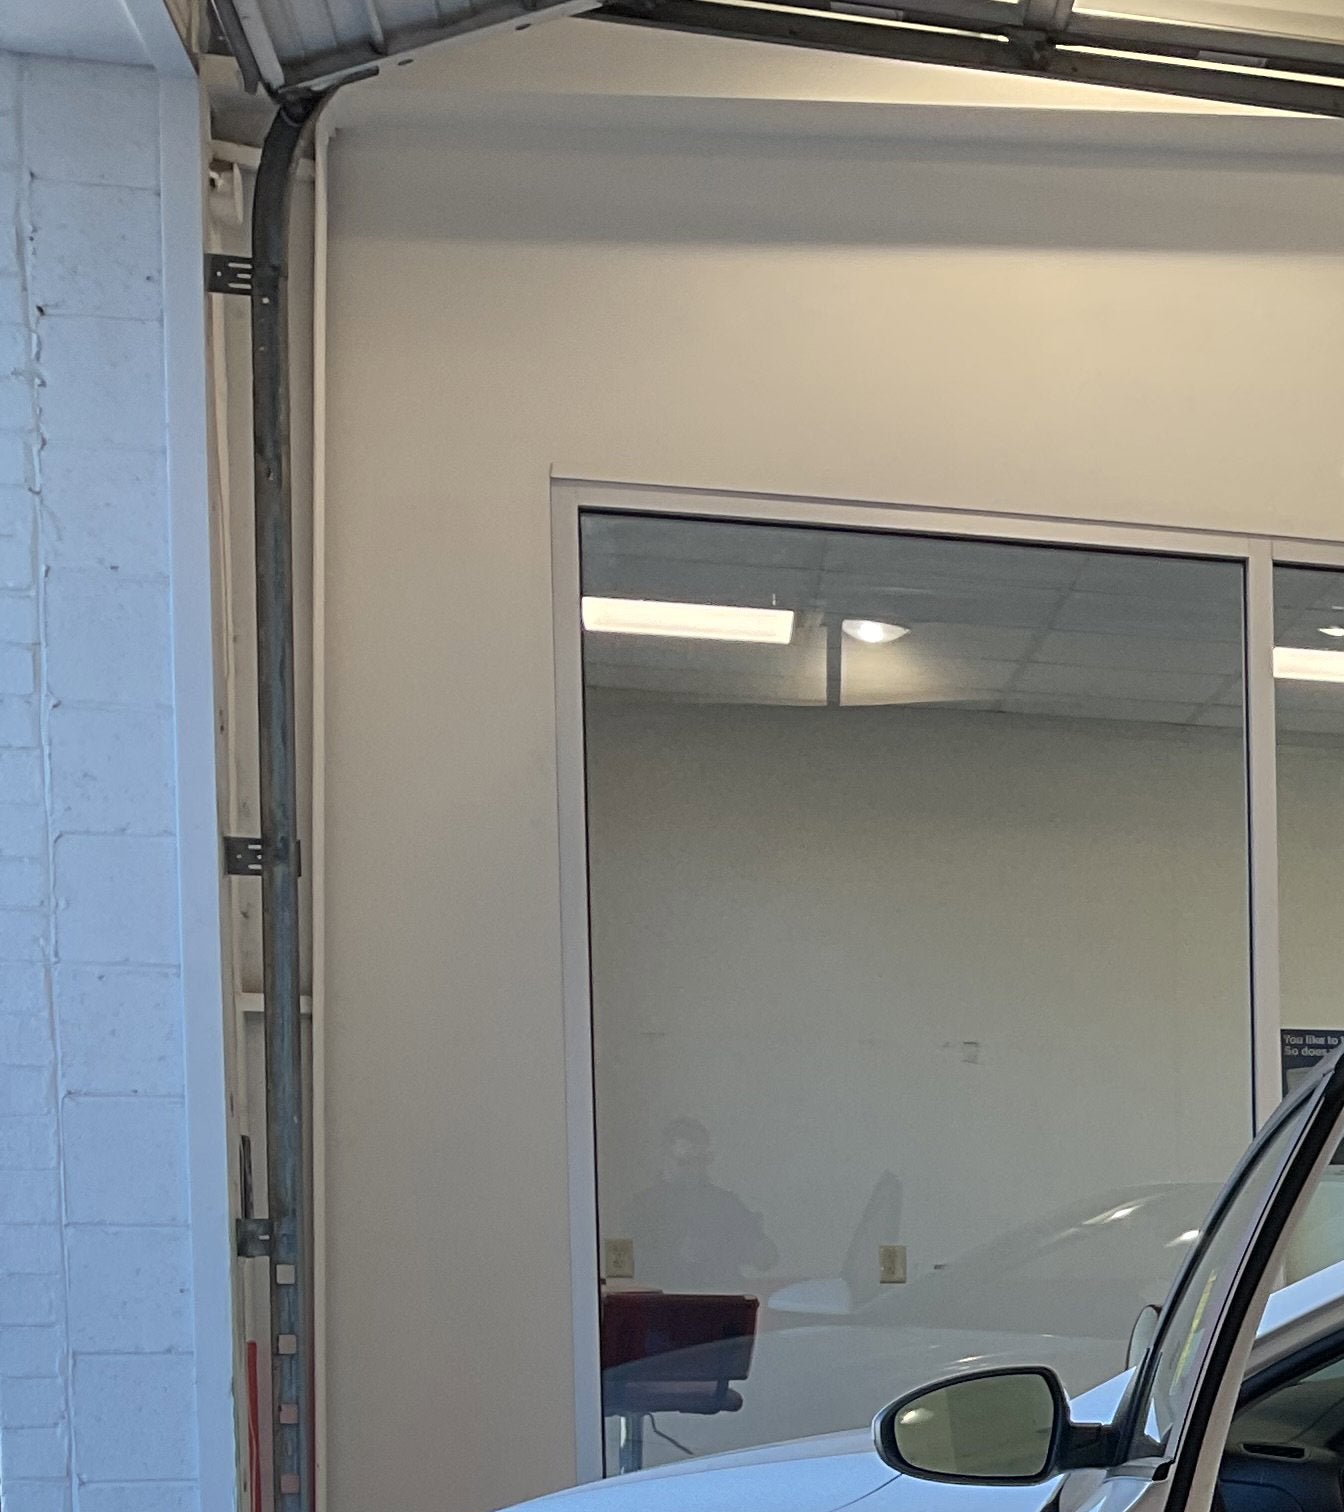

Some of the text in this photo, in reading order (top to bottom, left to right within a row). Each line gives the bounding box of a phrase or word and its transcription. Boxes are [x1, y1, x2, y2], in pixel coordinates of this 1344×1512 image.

[1285, 1035, 1303, 1044] You
[1305, 1035, 1325, 1045] like
[1327, 1036, 1338, 1044] to
[1284, 1046, 1299, 1056] So
